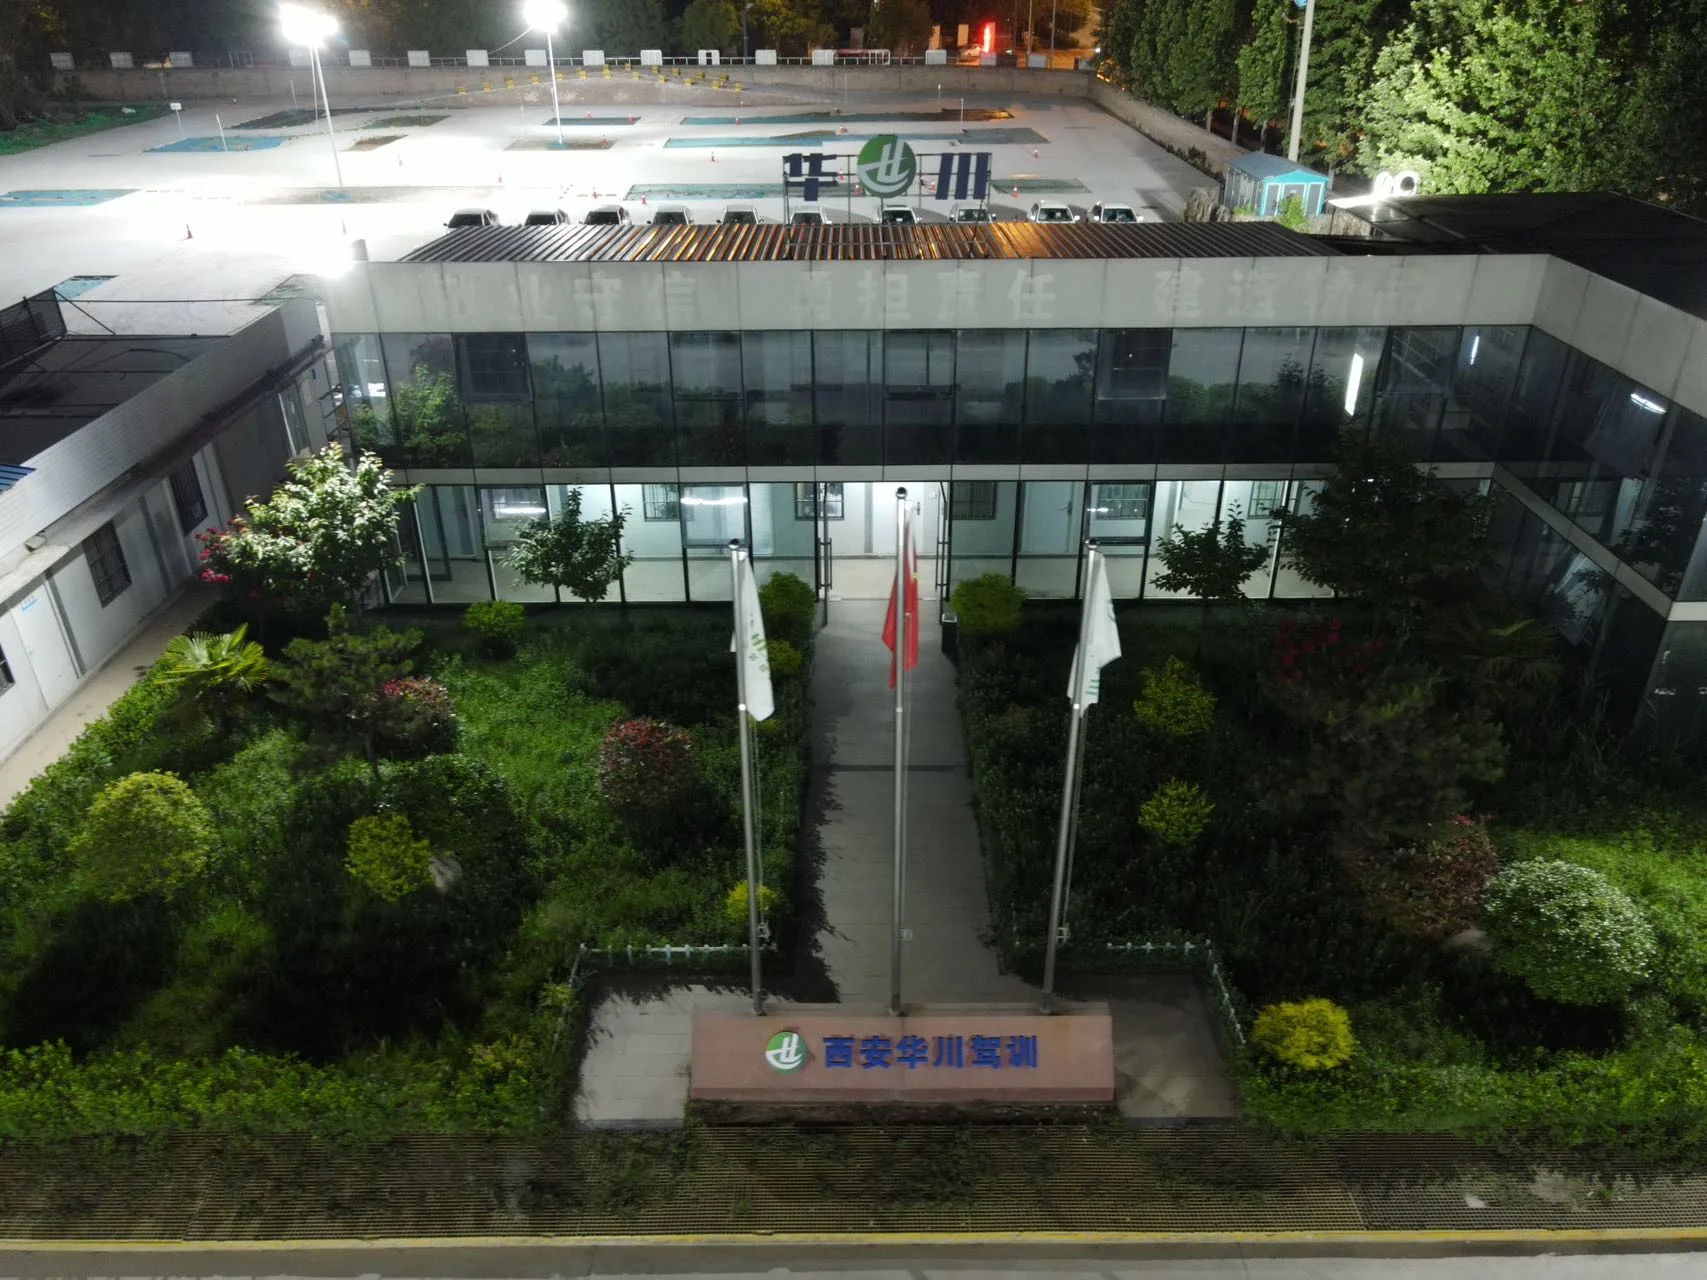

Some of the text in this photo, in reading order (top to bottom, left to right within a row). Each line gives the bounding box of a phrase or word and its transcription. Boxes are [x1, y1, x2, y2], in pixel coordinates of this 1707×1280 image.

[783, 152, 838, 202] 华
[823, 1034, 1039, 1069] 西安华川驾训
